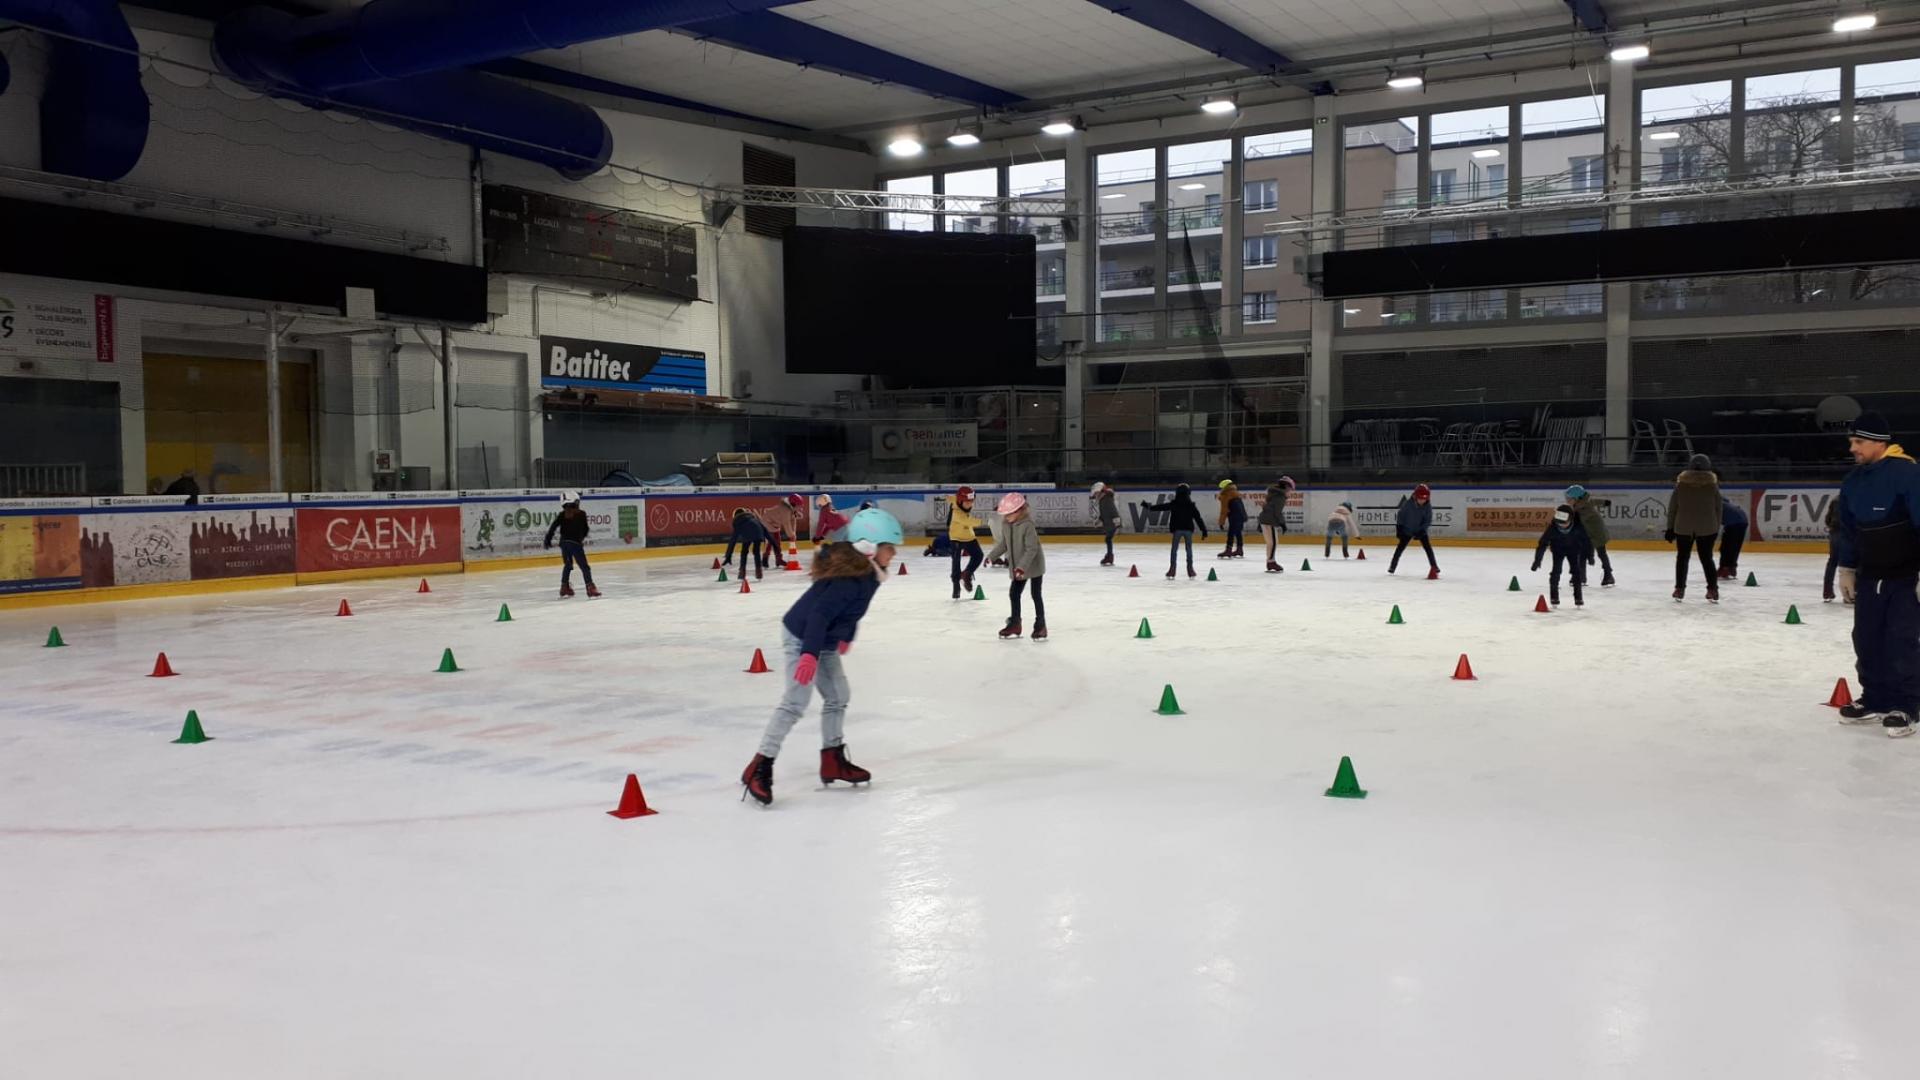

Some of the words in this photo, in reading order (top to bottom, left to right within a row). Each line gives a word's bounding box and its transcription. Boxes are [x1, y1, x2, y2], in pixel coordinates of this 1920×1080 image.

[550, 345, 631, 382] Batitec
[674, 509, 726, 523] NORMA
[1358, 512, 1389, 522] HOME
[1473, 511, 1486, 520] 02
[1489, 511, 1499, 520] 31
[1503, 511, 1516, 520] 93
[1519, 511, 1532, 520] 97
[1535, 511, 1548, 520] 97
